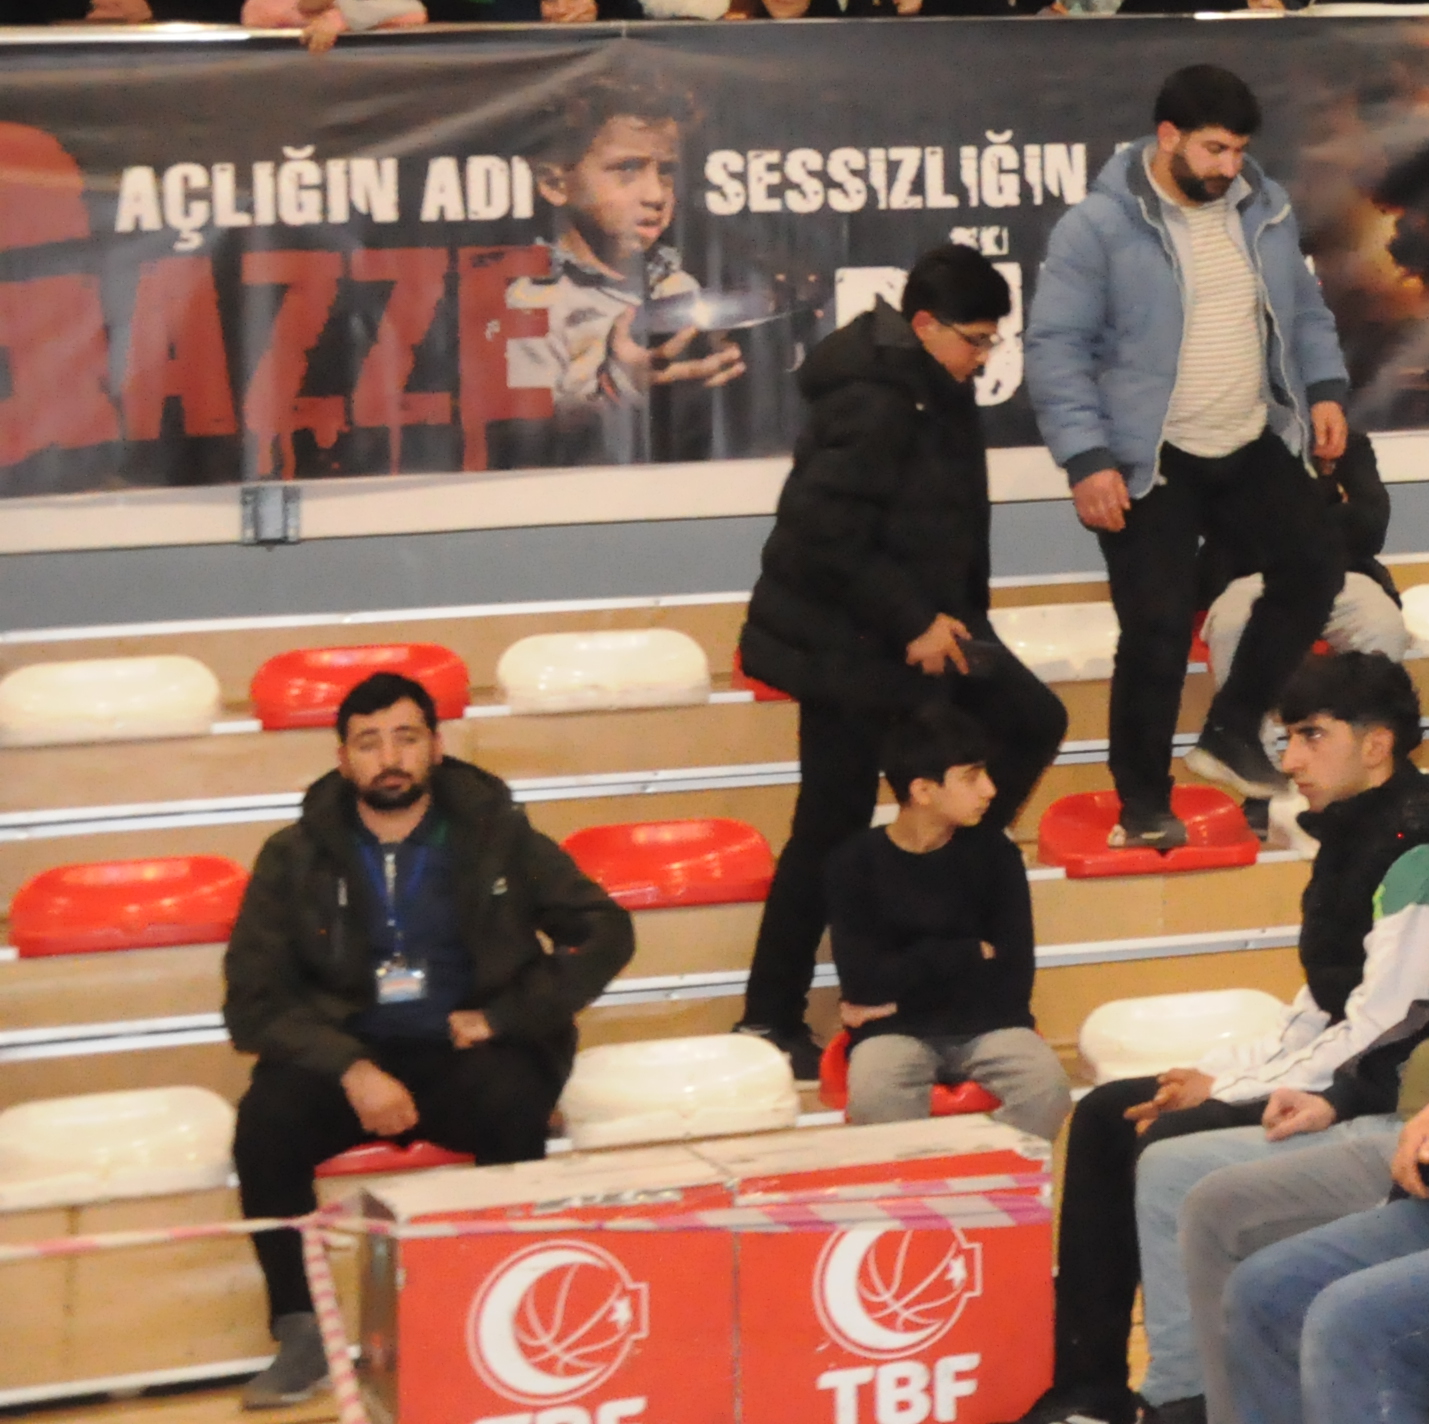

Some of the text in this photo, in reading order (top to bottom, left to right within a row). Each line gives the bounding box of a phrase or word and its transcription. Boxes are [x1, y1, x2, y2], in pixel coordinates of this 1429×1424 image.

[114, 144, 399, 252] AÇLIĞIN
[419, 154, 534, 223] ADI
[815, 1352, 982, 1424] TBF
